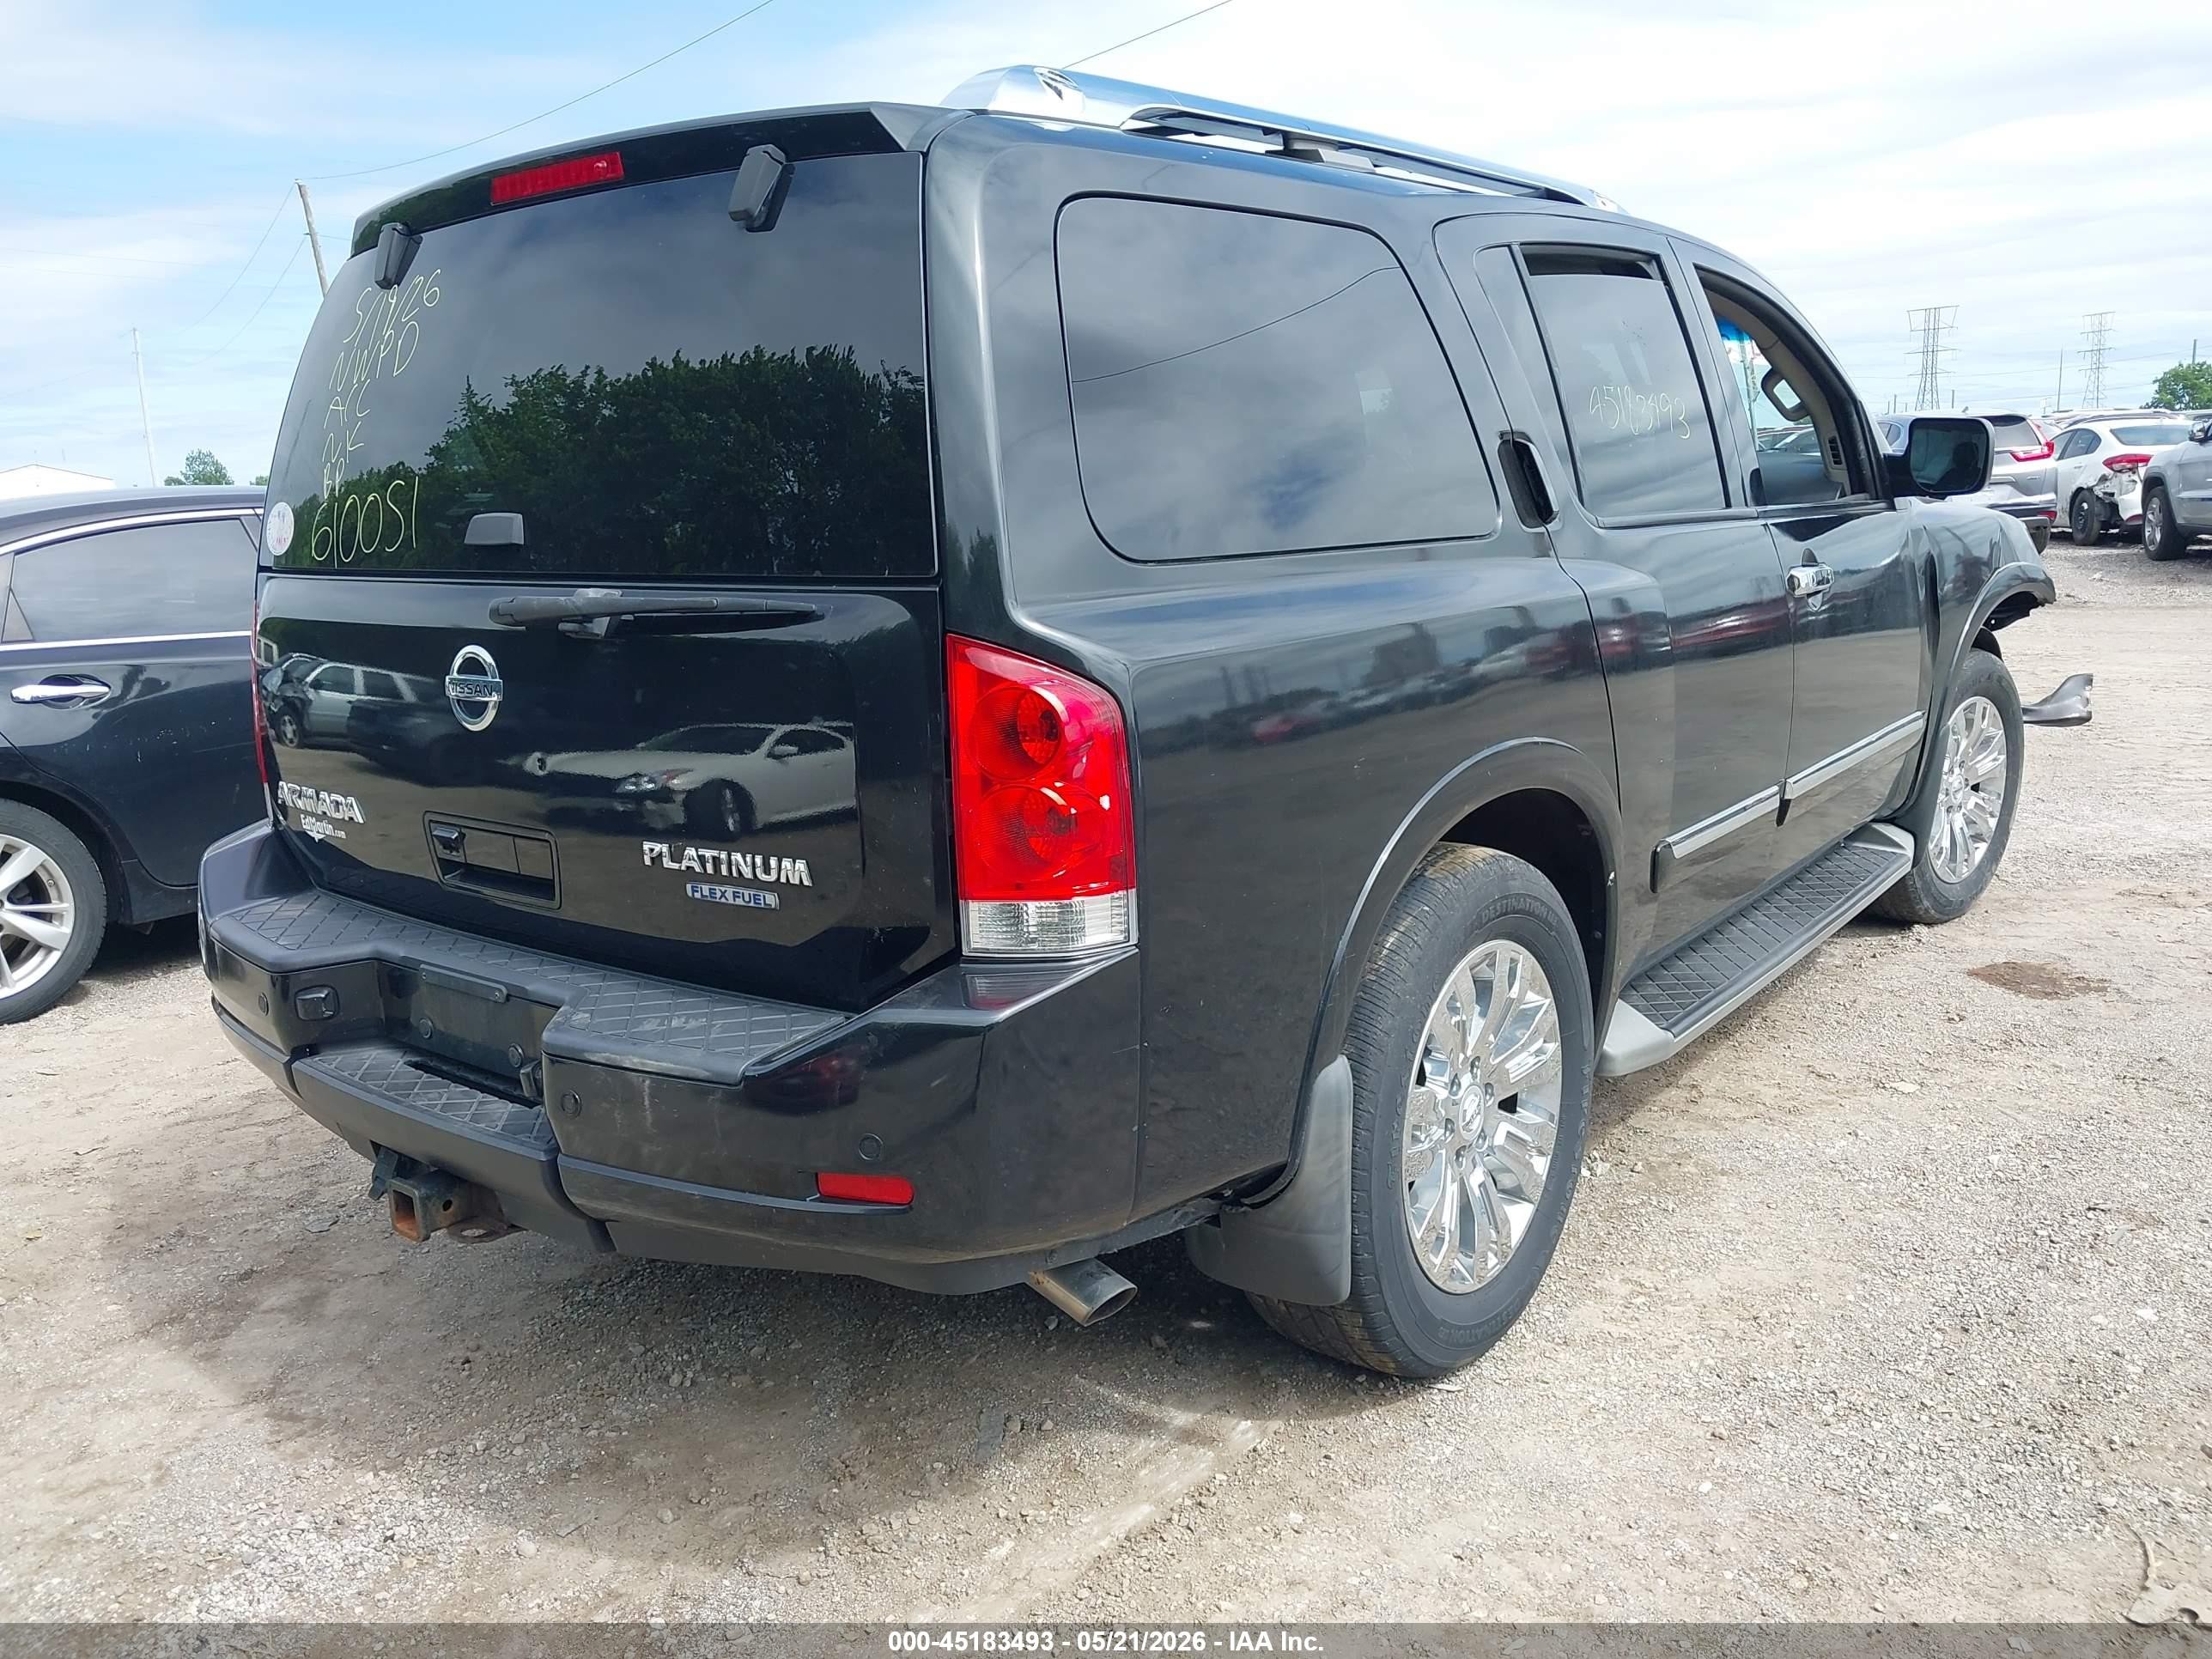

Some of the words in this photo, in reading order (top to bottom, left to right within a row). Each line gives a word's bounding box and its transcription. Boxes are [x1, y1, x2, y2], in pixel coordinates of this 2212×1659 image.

[448, 681, 493, 696] NISSAN
[277, 781, 365, 823] ARMADA
[642, 842, 812, 887] PLATINUM
[690, 884, 729, 902] FLEX
[732, 890, 774, 907] FUEL
